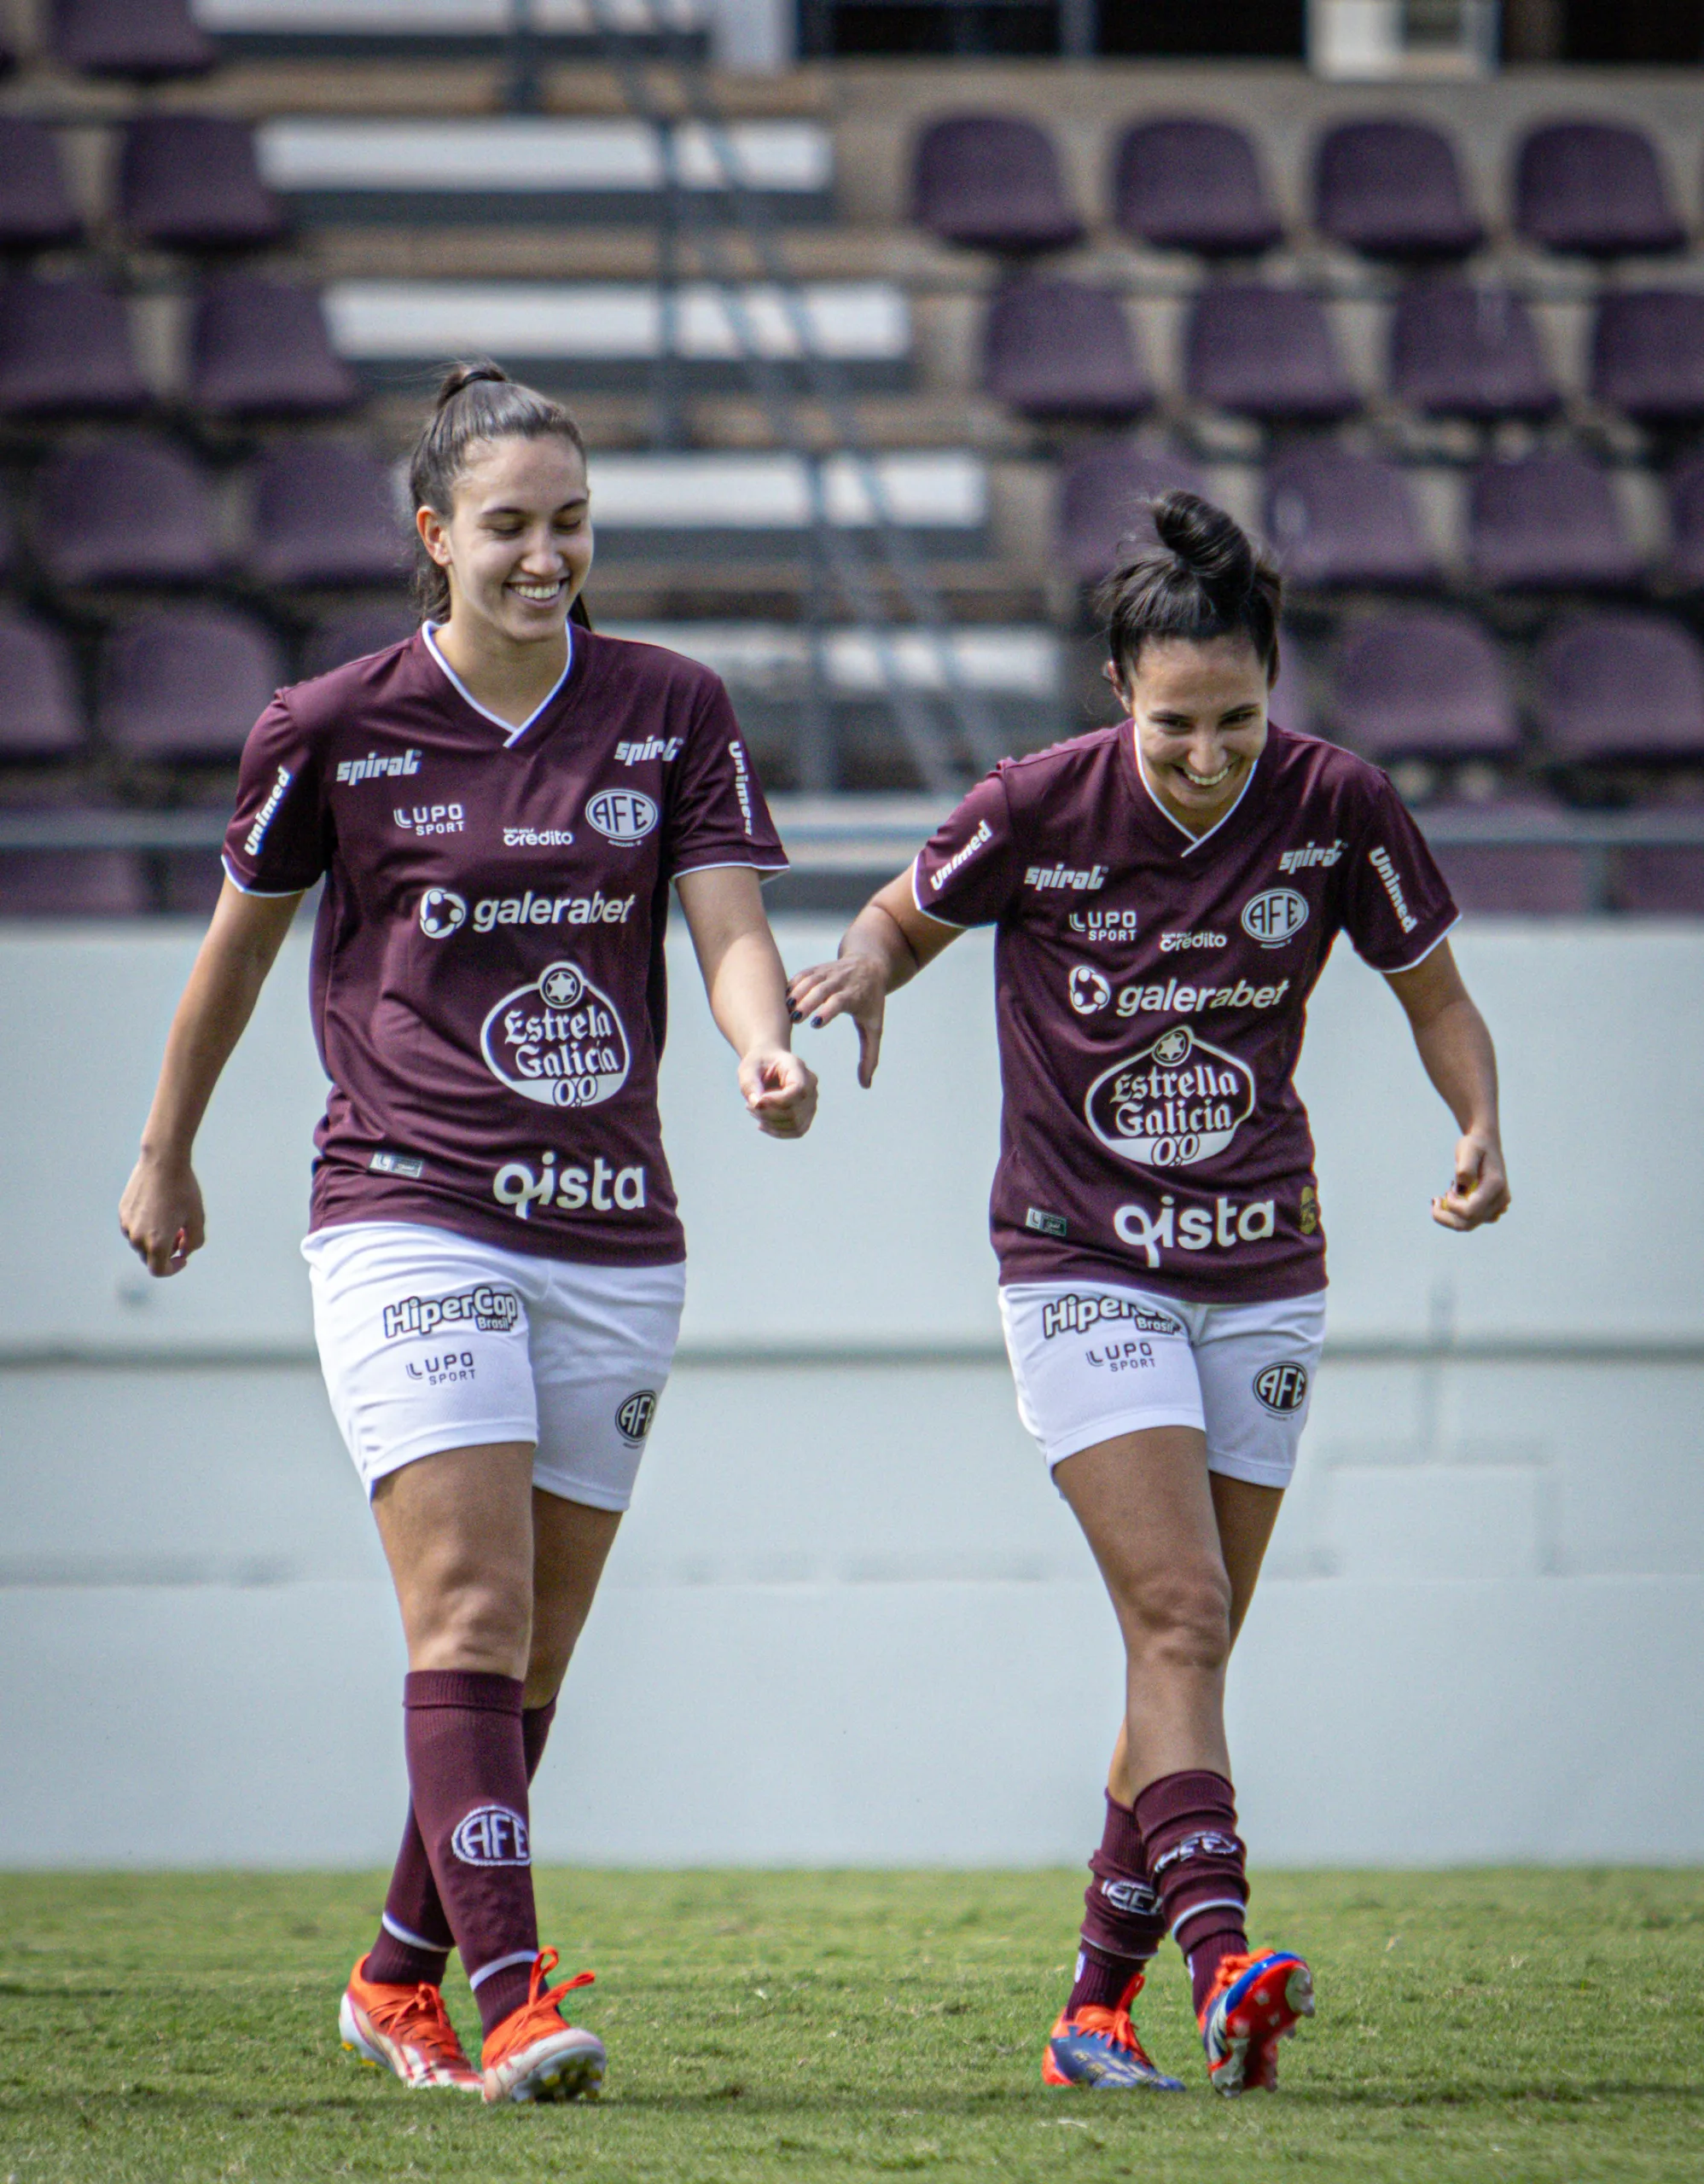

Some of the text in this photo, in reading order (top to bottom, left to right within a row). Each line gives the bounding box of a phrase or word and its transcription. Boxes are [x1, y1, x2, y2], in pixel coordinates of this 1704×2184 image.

[336, 749, 422, 786] spiral
[244, 764, 291, 857] Unimed
[393, 804, 463, 828] LUPO
[416, 820, 465, 836] SPORT
[594, 794, 648, 834] AFE
[930, 820, 992, 891] Unimed
[1023, 863, 1106, 891] spiral
[1368, 846, 1418, 934] Unimed
[473, 891, 636, 932] galerabet
[1069, 910, 1137, 932] LUPO
[1248, 896, 1298, 935] AFE
[1088, 929, 1137, 941] SPORT
[1116, 979, 1288, 1017] galerabet
[1110, 1066, 1239, 1103] Estrella
[1115, 1100, 1232, 1136] Galicia
[384, 1287, 518, 1338] HiperCap
[477, 1316, 510, 1331] Brasil
[405, 1352, 474, 1380] LUPO
[1085, 1343, 1153, 1367] LUPO
[1110, 1358, 1156, 1373] SPORT
[429, 1369, 476, 1385] SPORT
[1256, 1365, 1306, 1409] AFE
[462, 1814, 529, 1858] AFE
